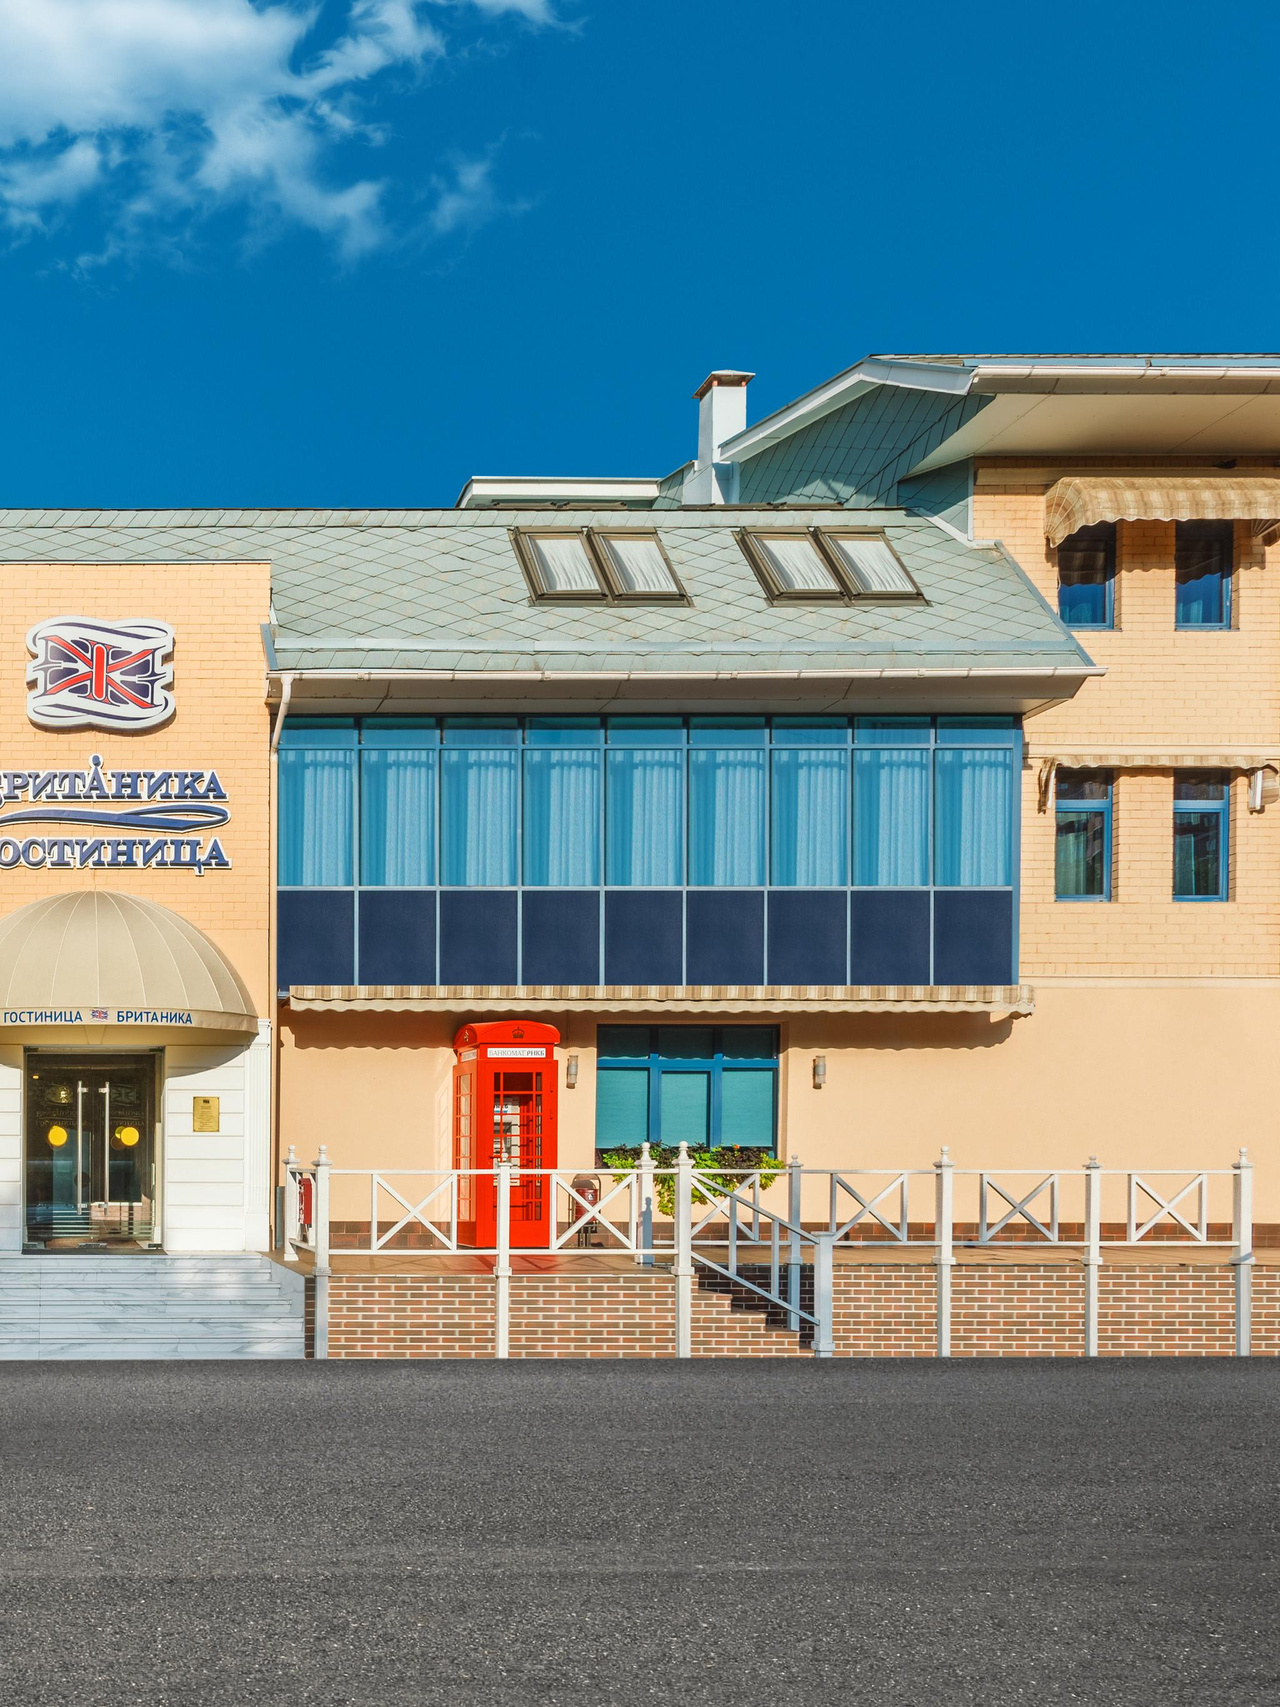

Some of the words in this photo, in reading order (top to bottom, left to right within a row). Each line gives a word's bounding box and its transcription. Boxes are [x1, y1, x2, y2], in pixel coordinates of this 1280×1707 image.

[3, 1010, 83, 1024] ГОСТИНИЦА
[116, 1010, 193, 1024] БРИТАНИКА
[488, 1049, 525, 1057] БАНКОМАТ
[526, 1049, 545, 1057] РНКБ
